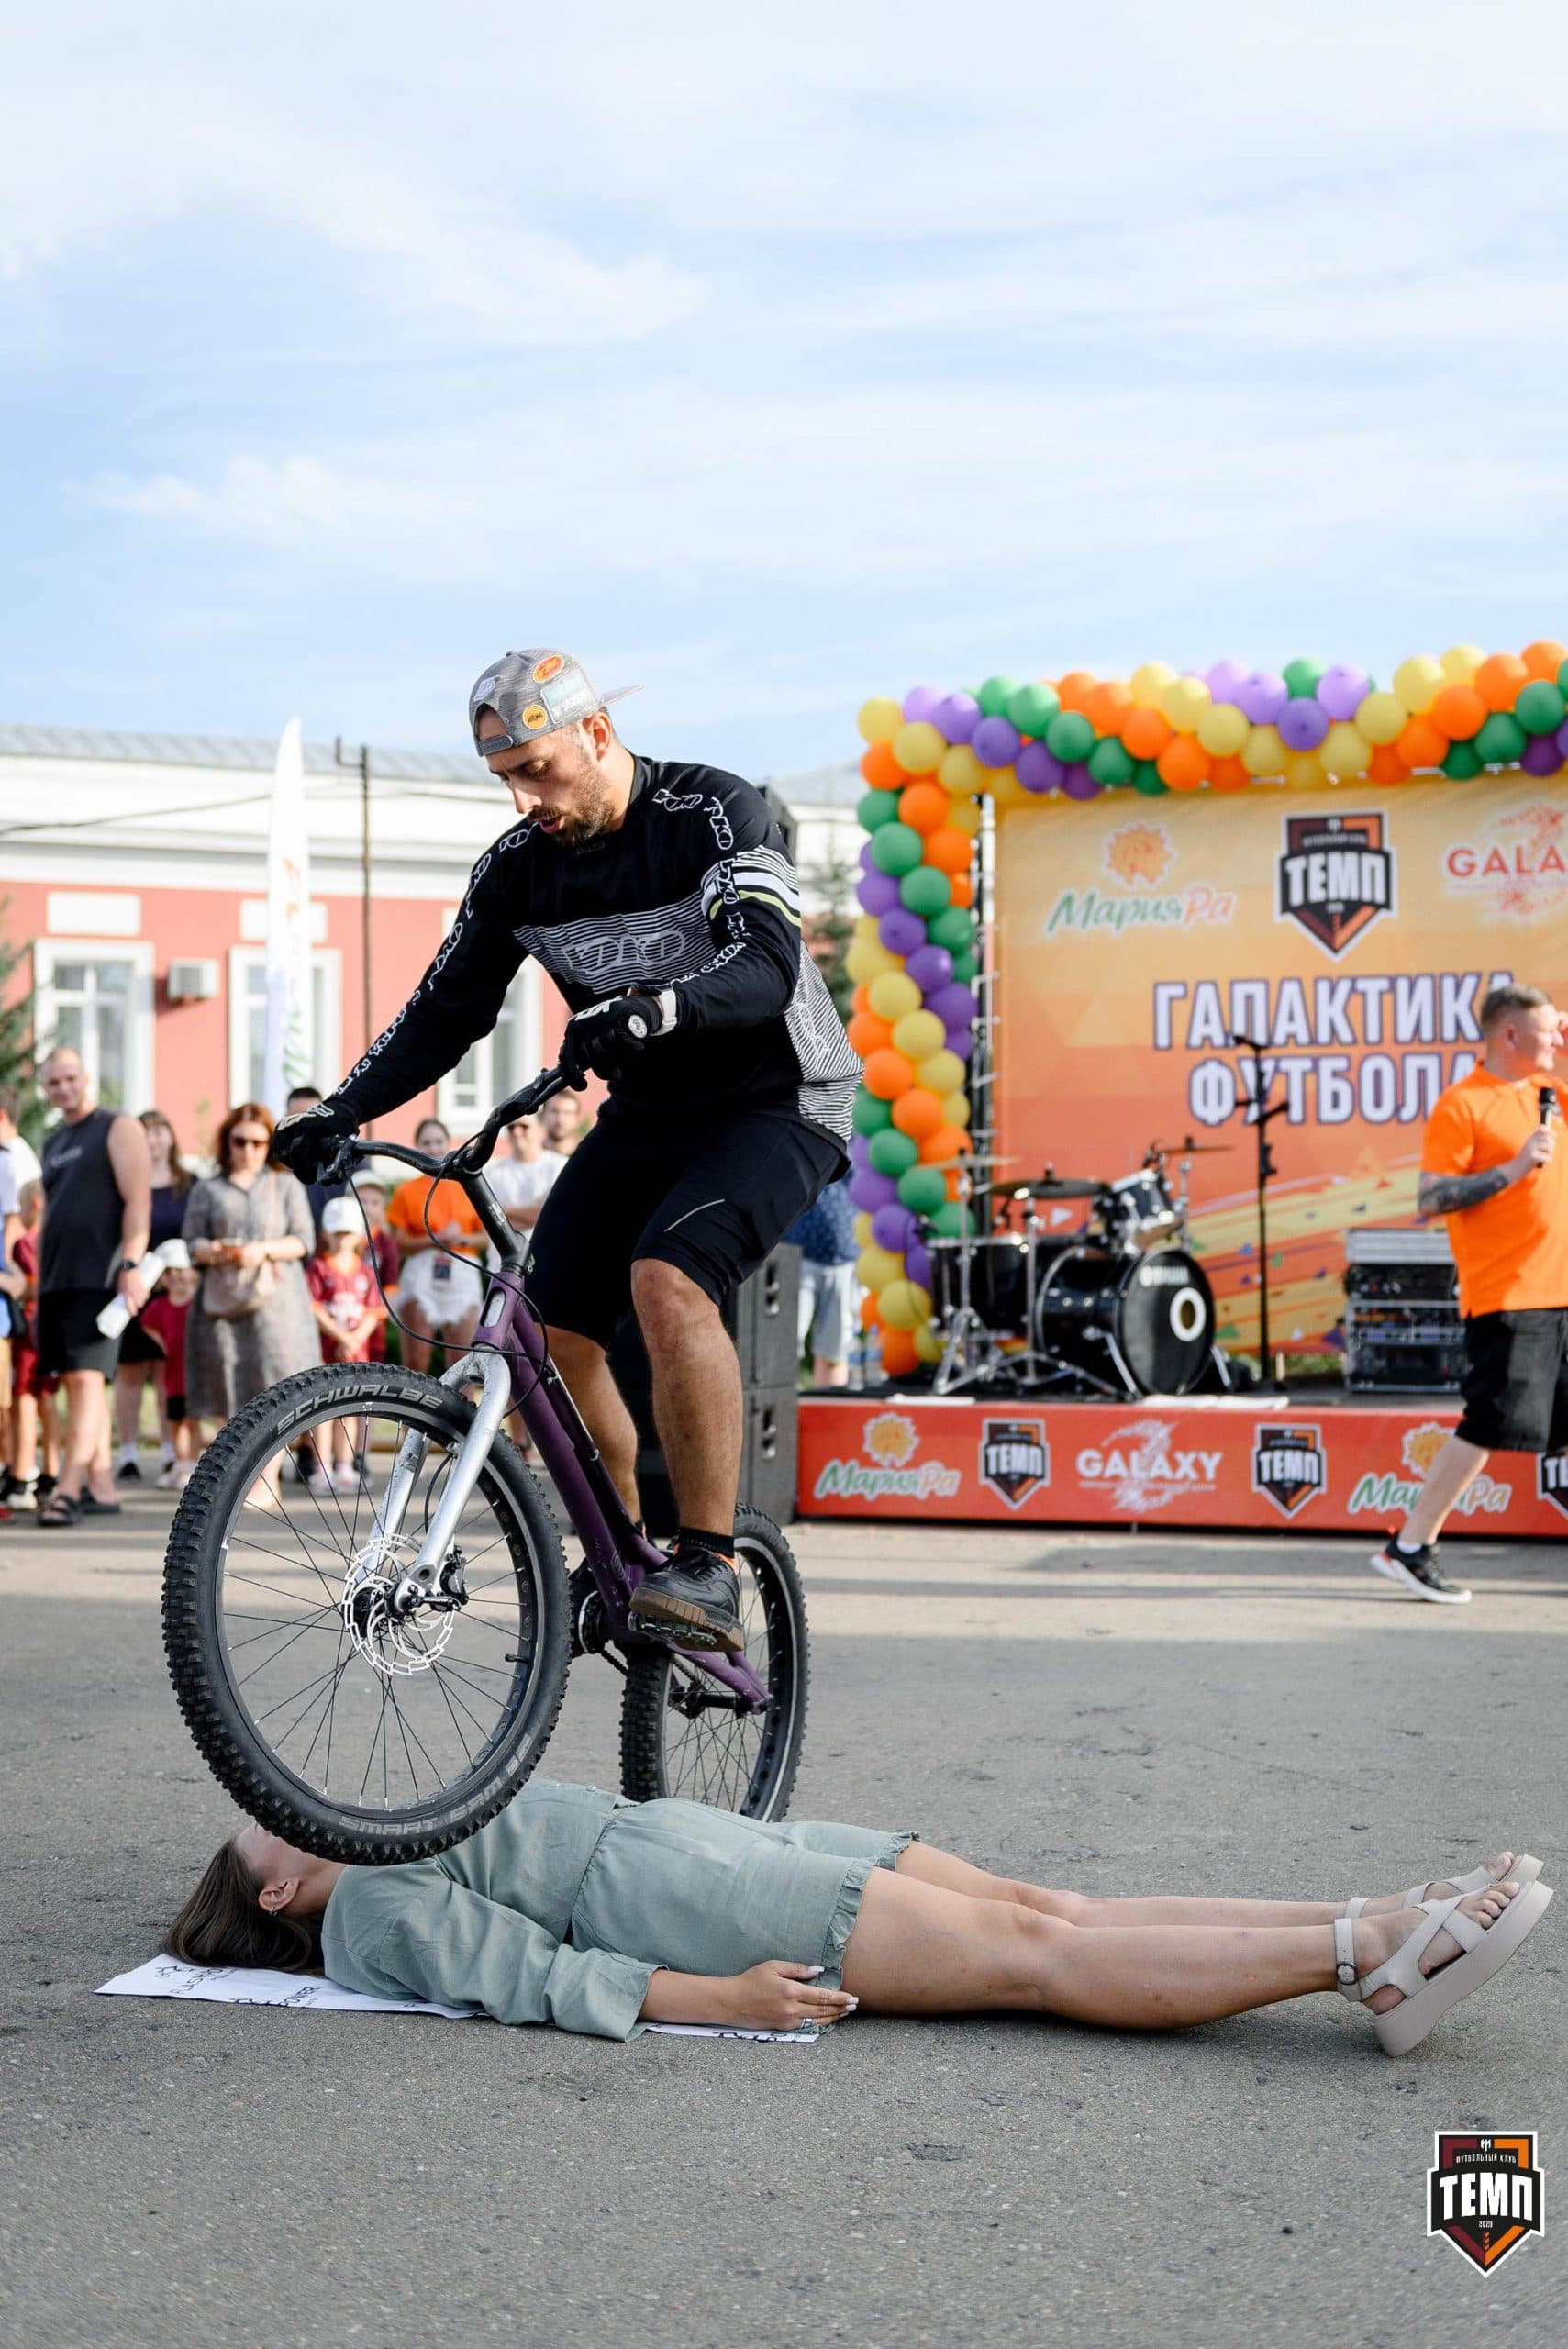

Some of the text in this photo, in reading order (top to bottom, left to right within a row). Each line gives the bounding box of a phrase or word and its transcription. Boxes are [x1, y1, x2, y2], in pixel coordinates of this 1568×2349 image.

[1285, 851, 1386, 907] ТЕМП
[1153, 971, 1514, 1051] ГАЛАКТИК
[277, 1384, 444, 1437] SCHWALBE
[986, 1442, 1044, 1476] ТЕМП
[1075, 1448, 1223, 1481] GALAXY
[1259, 1450, 1319, 1484] ТЕМП
